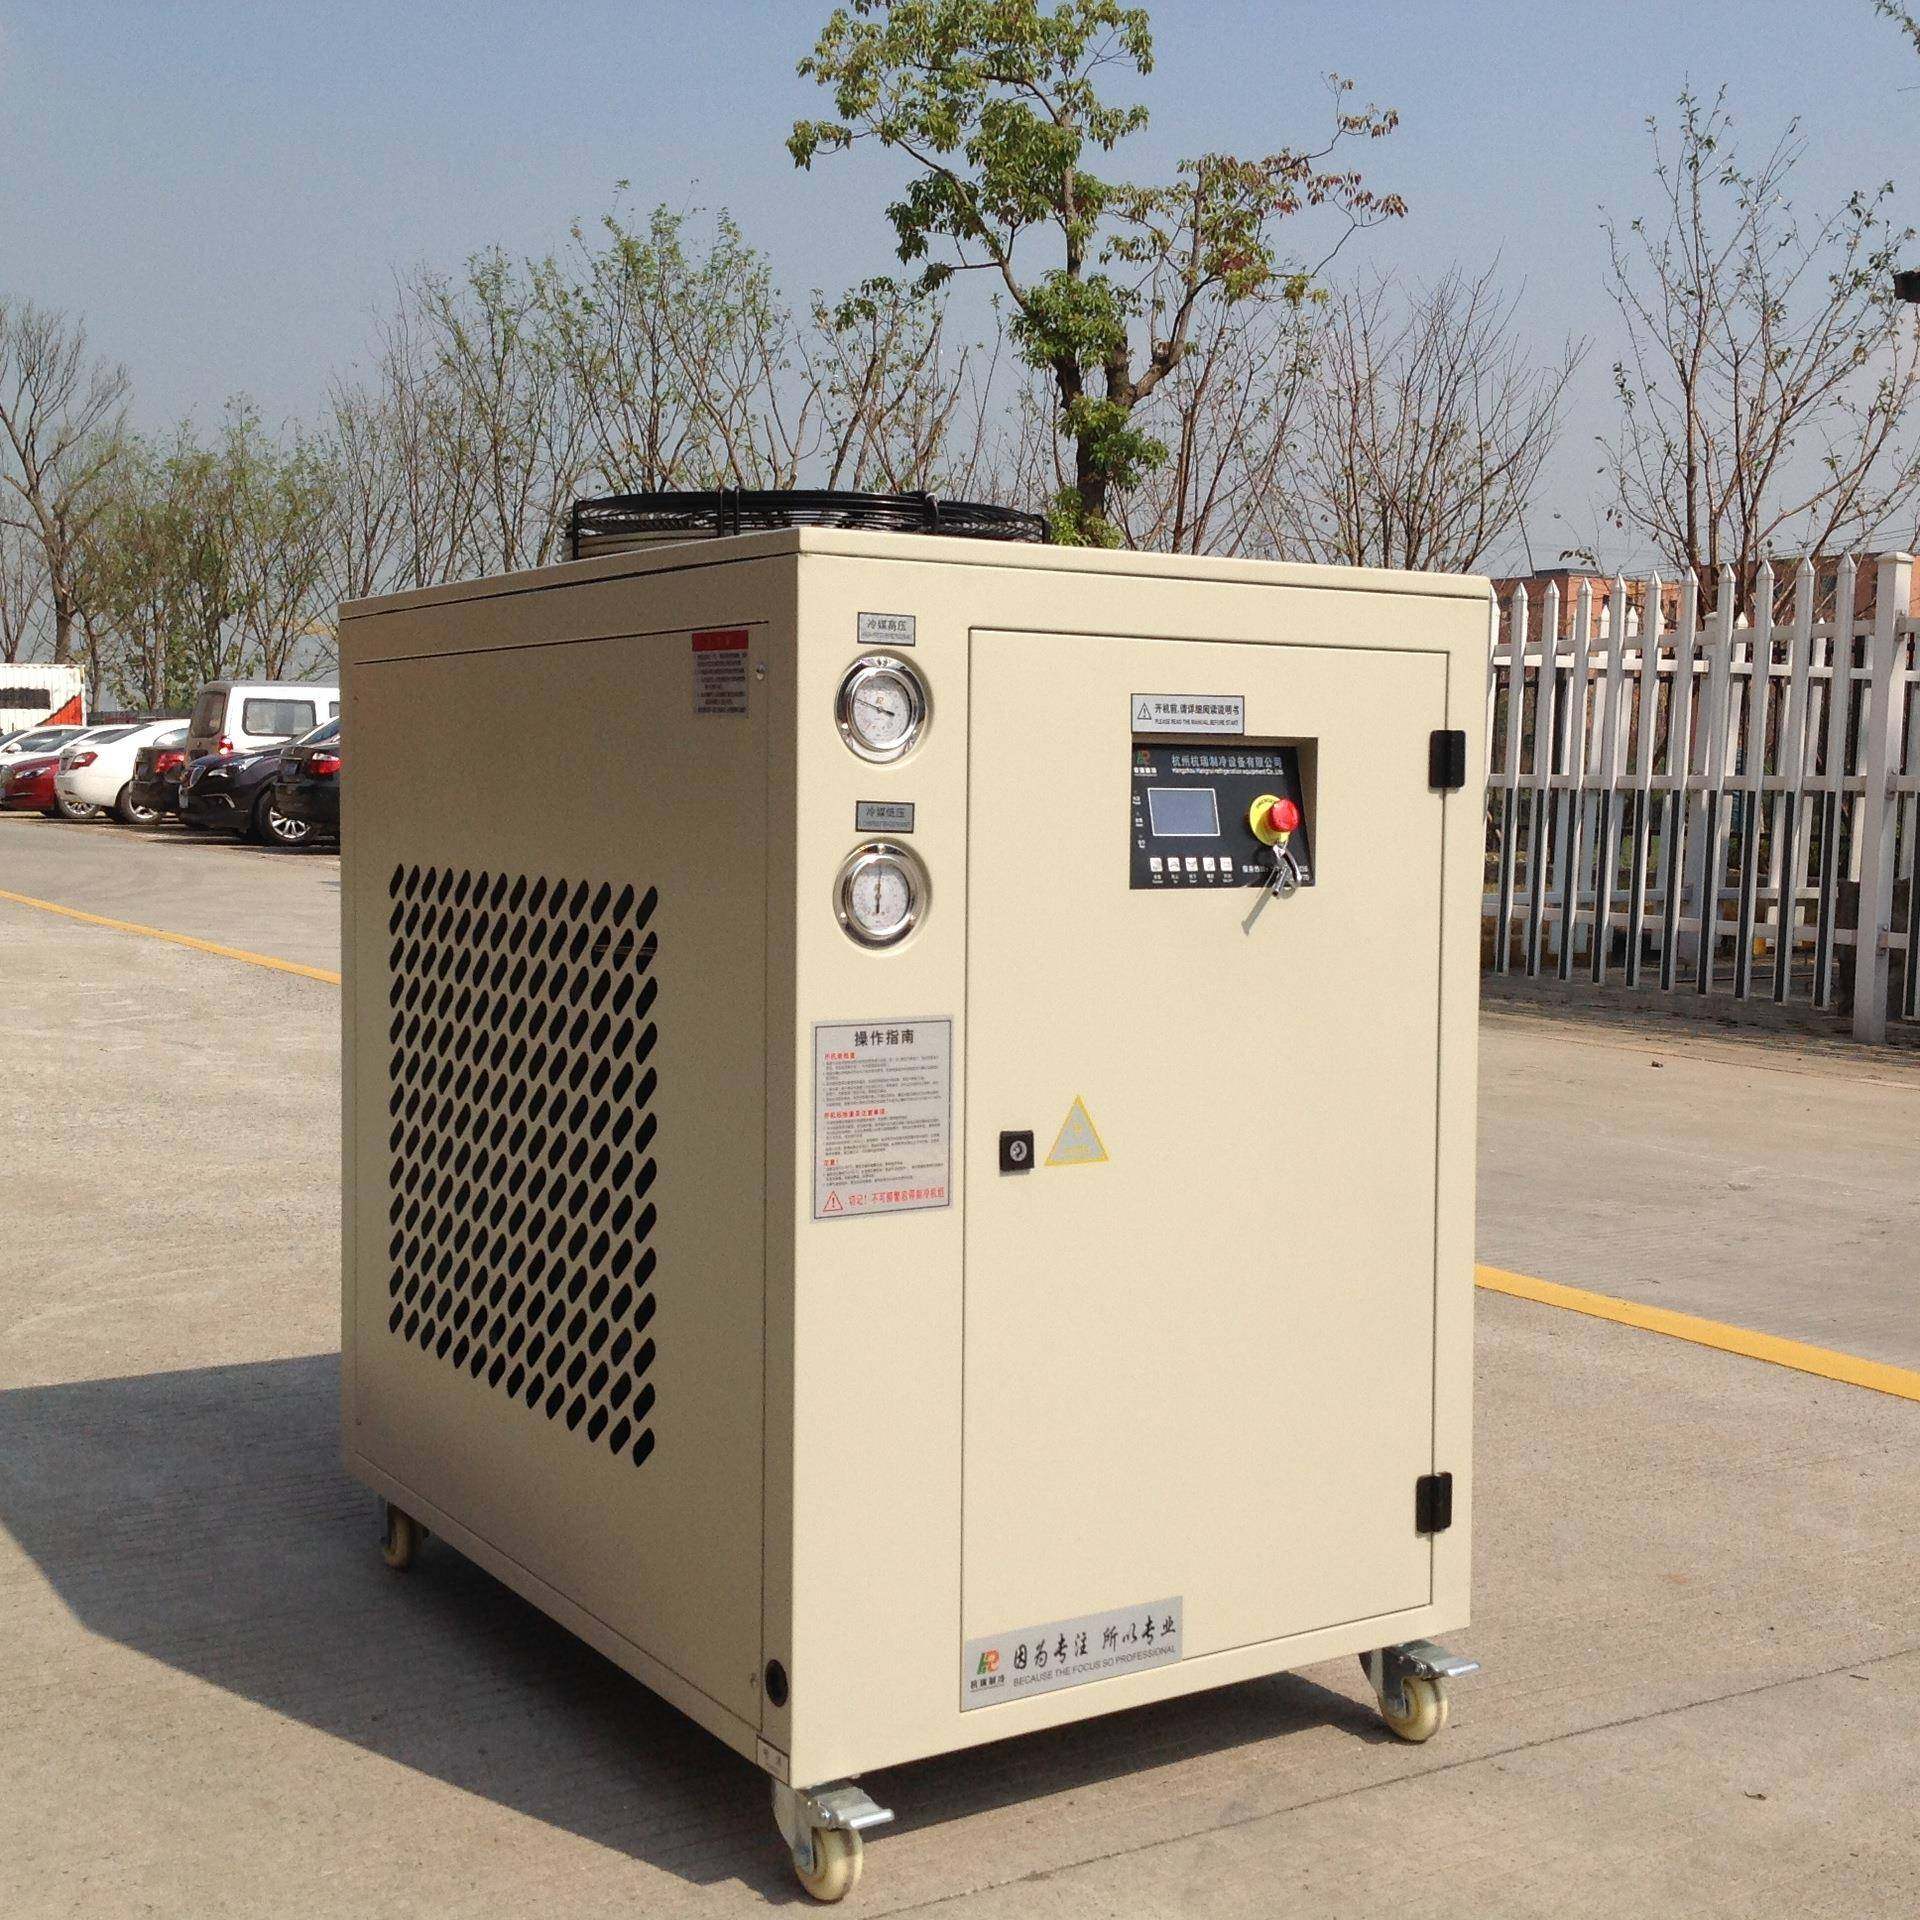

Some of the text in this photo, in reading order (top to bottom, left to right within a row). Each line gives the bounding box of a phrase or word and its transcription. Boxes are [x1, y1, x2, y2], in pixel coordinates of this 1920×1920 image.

[854, 1029, 914, 1047] 操作指南
[1013, 1615, 1176, 1671] 因为专注 所以专业
[1013, 1645, 1175, 1687] BECAUSE THE FOCUS SO PROFESSIONAL
